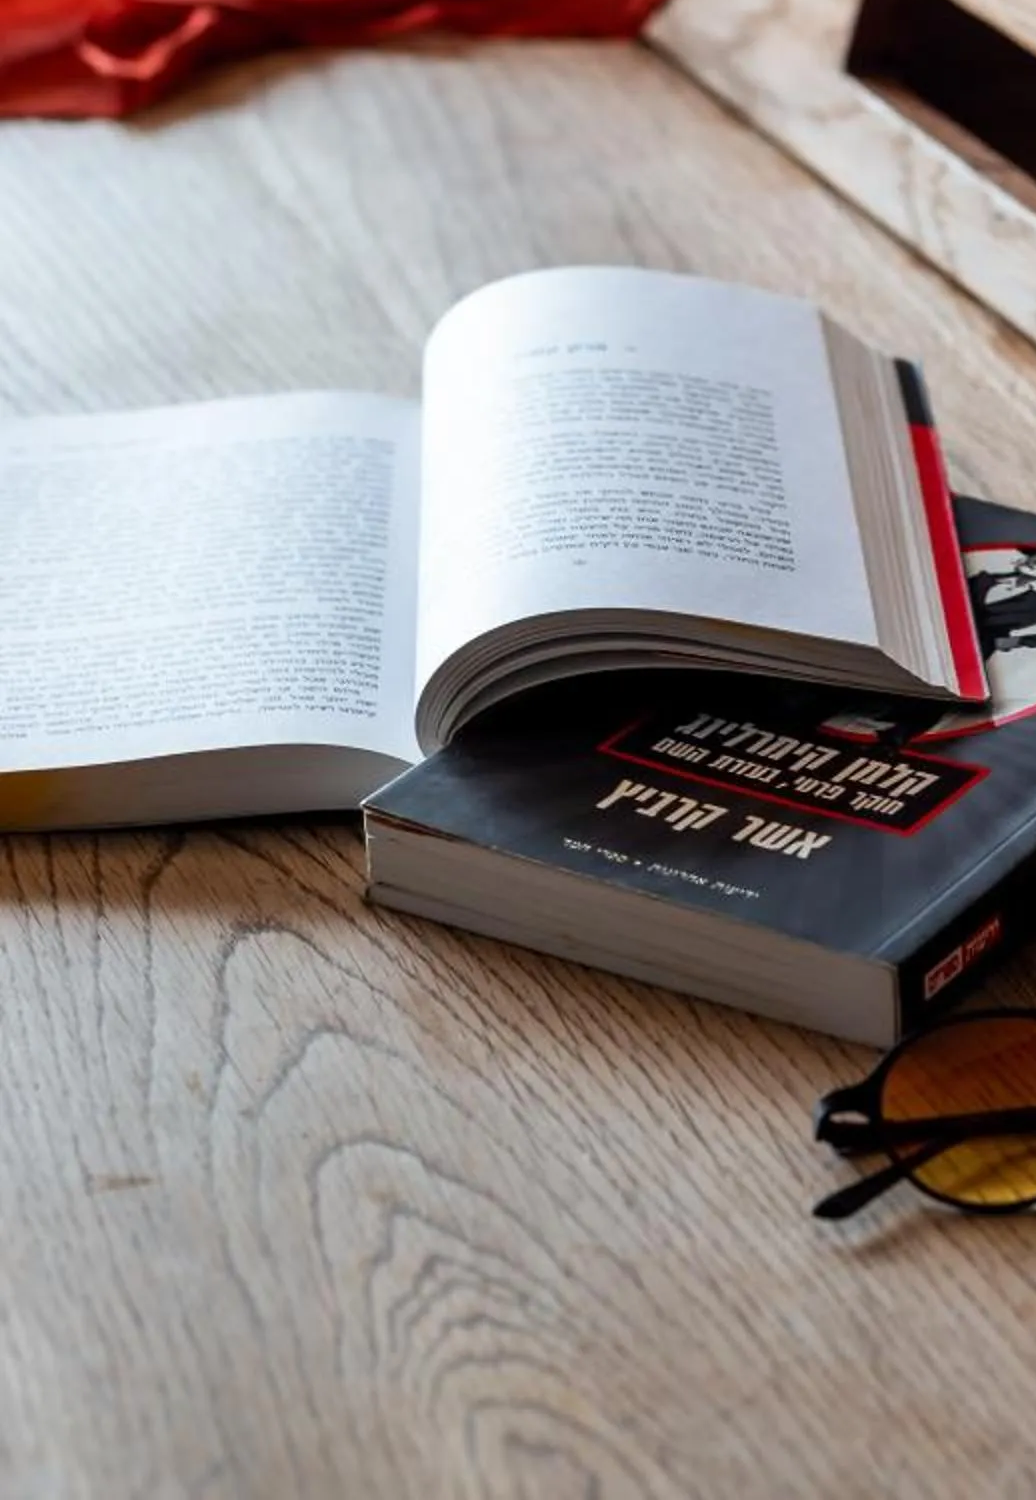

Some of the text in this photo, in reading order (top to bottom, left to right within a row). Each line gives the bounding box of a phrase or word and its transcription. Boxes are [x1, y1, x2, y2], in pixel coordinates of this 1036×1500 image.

[651, 737, 711, 763] השם
[674, 713, 940, 797] קלמן קימרלינג
[707, 755, 782, 784] בעזרת
[849, 791, 904, 816] חוקר
[596, 779, 832, 860] אשר קרביץ
